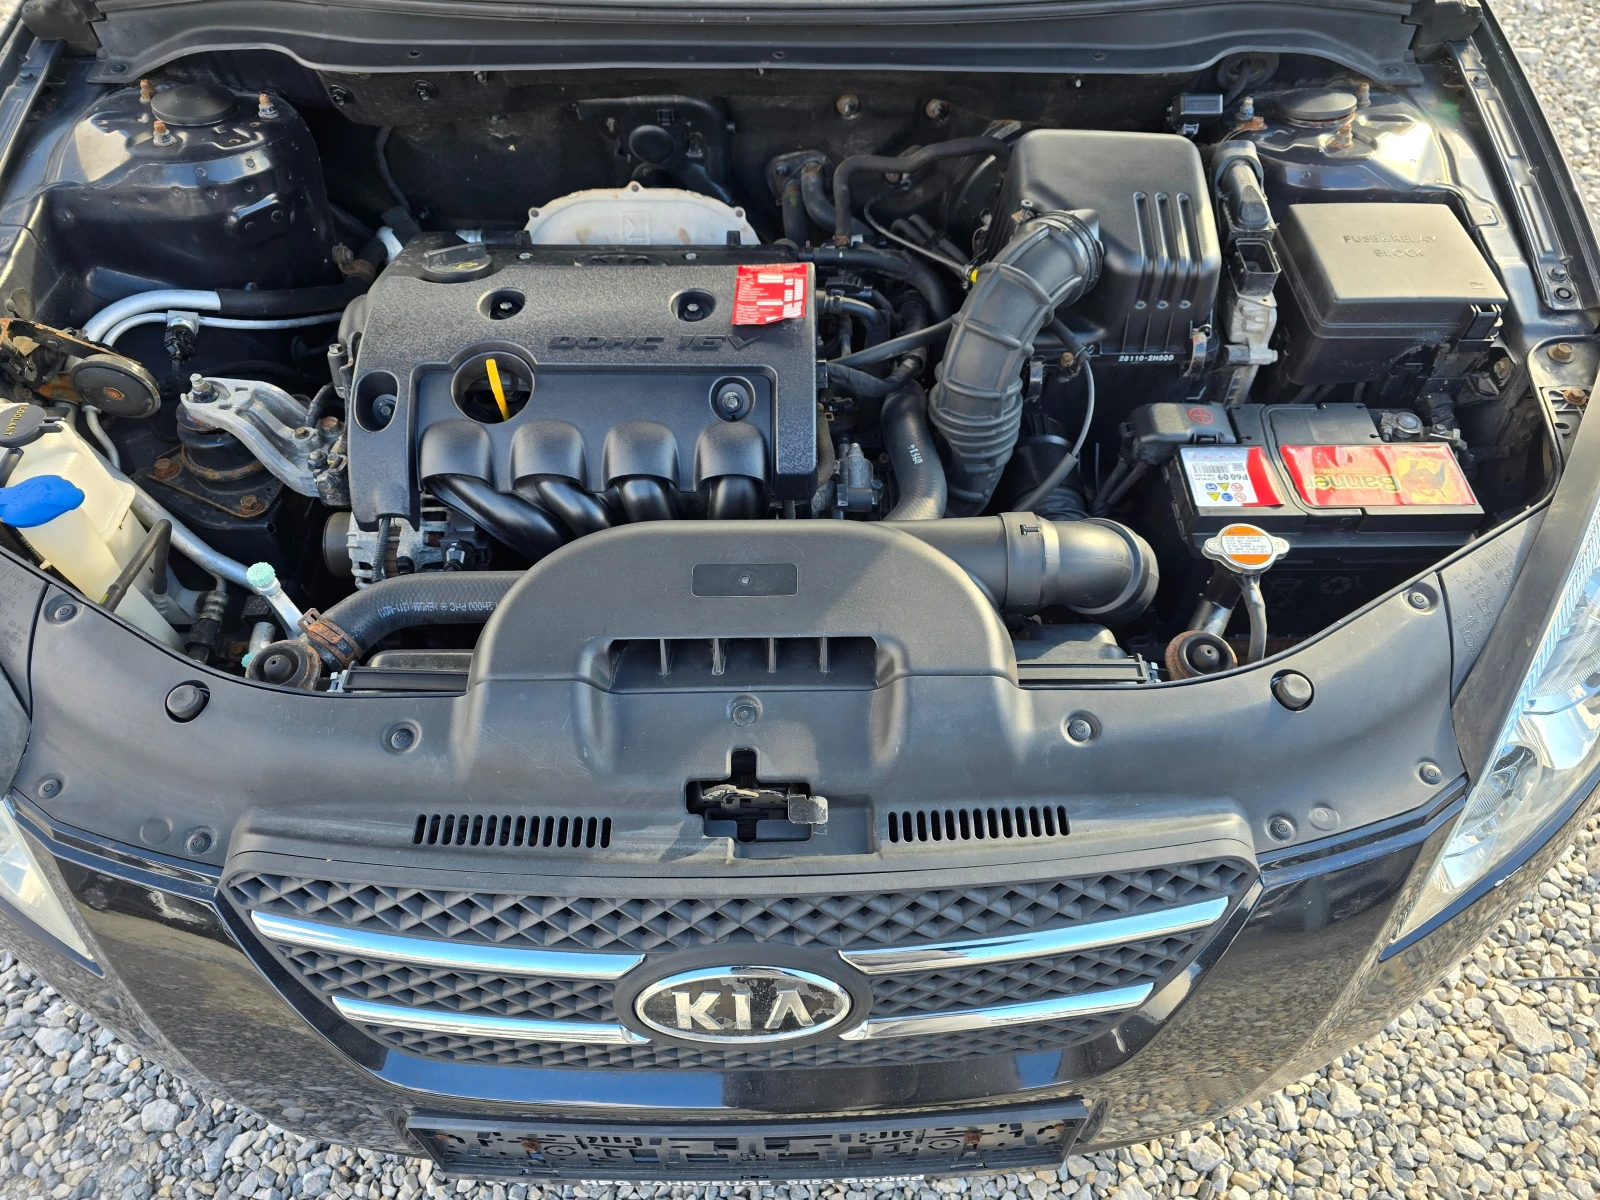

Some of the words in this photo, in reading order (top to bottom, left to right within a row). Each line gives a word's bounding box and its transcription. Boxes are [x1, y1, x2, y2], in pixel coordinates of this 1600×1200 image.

[1373, 248, 1426, 257] BLOCK
[549, 335, 665, 350] DOHC
[678, 335, 761, 350] 16V
[4, 404, 28, 437] COOLANT
[1217, 473, 1229, 481] 09
[1230, 473, 1249, 481] P60
[1305, 475, 1401, 492] Banner
[671, 988, 816, 1030] KIA
[841, 1174, 925, 1184] Gmünd
